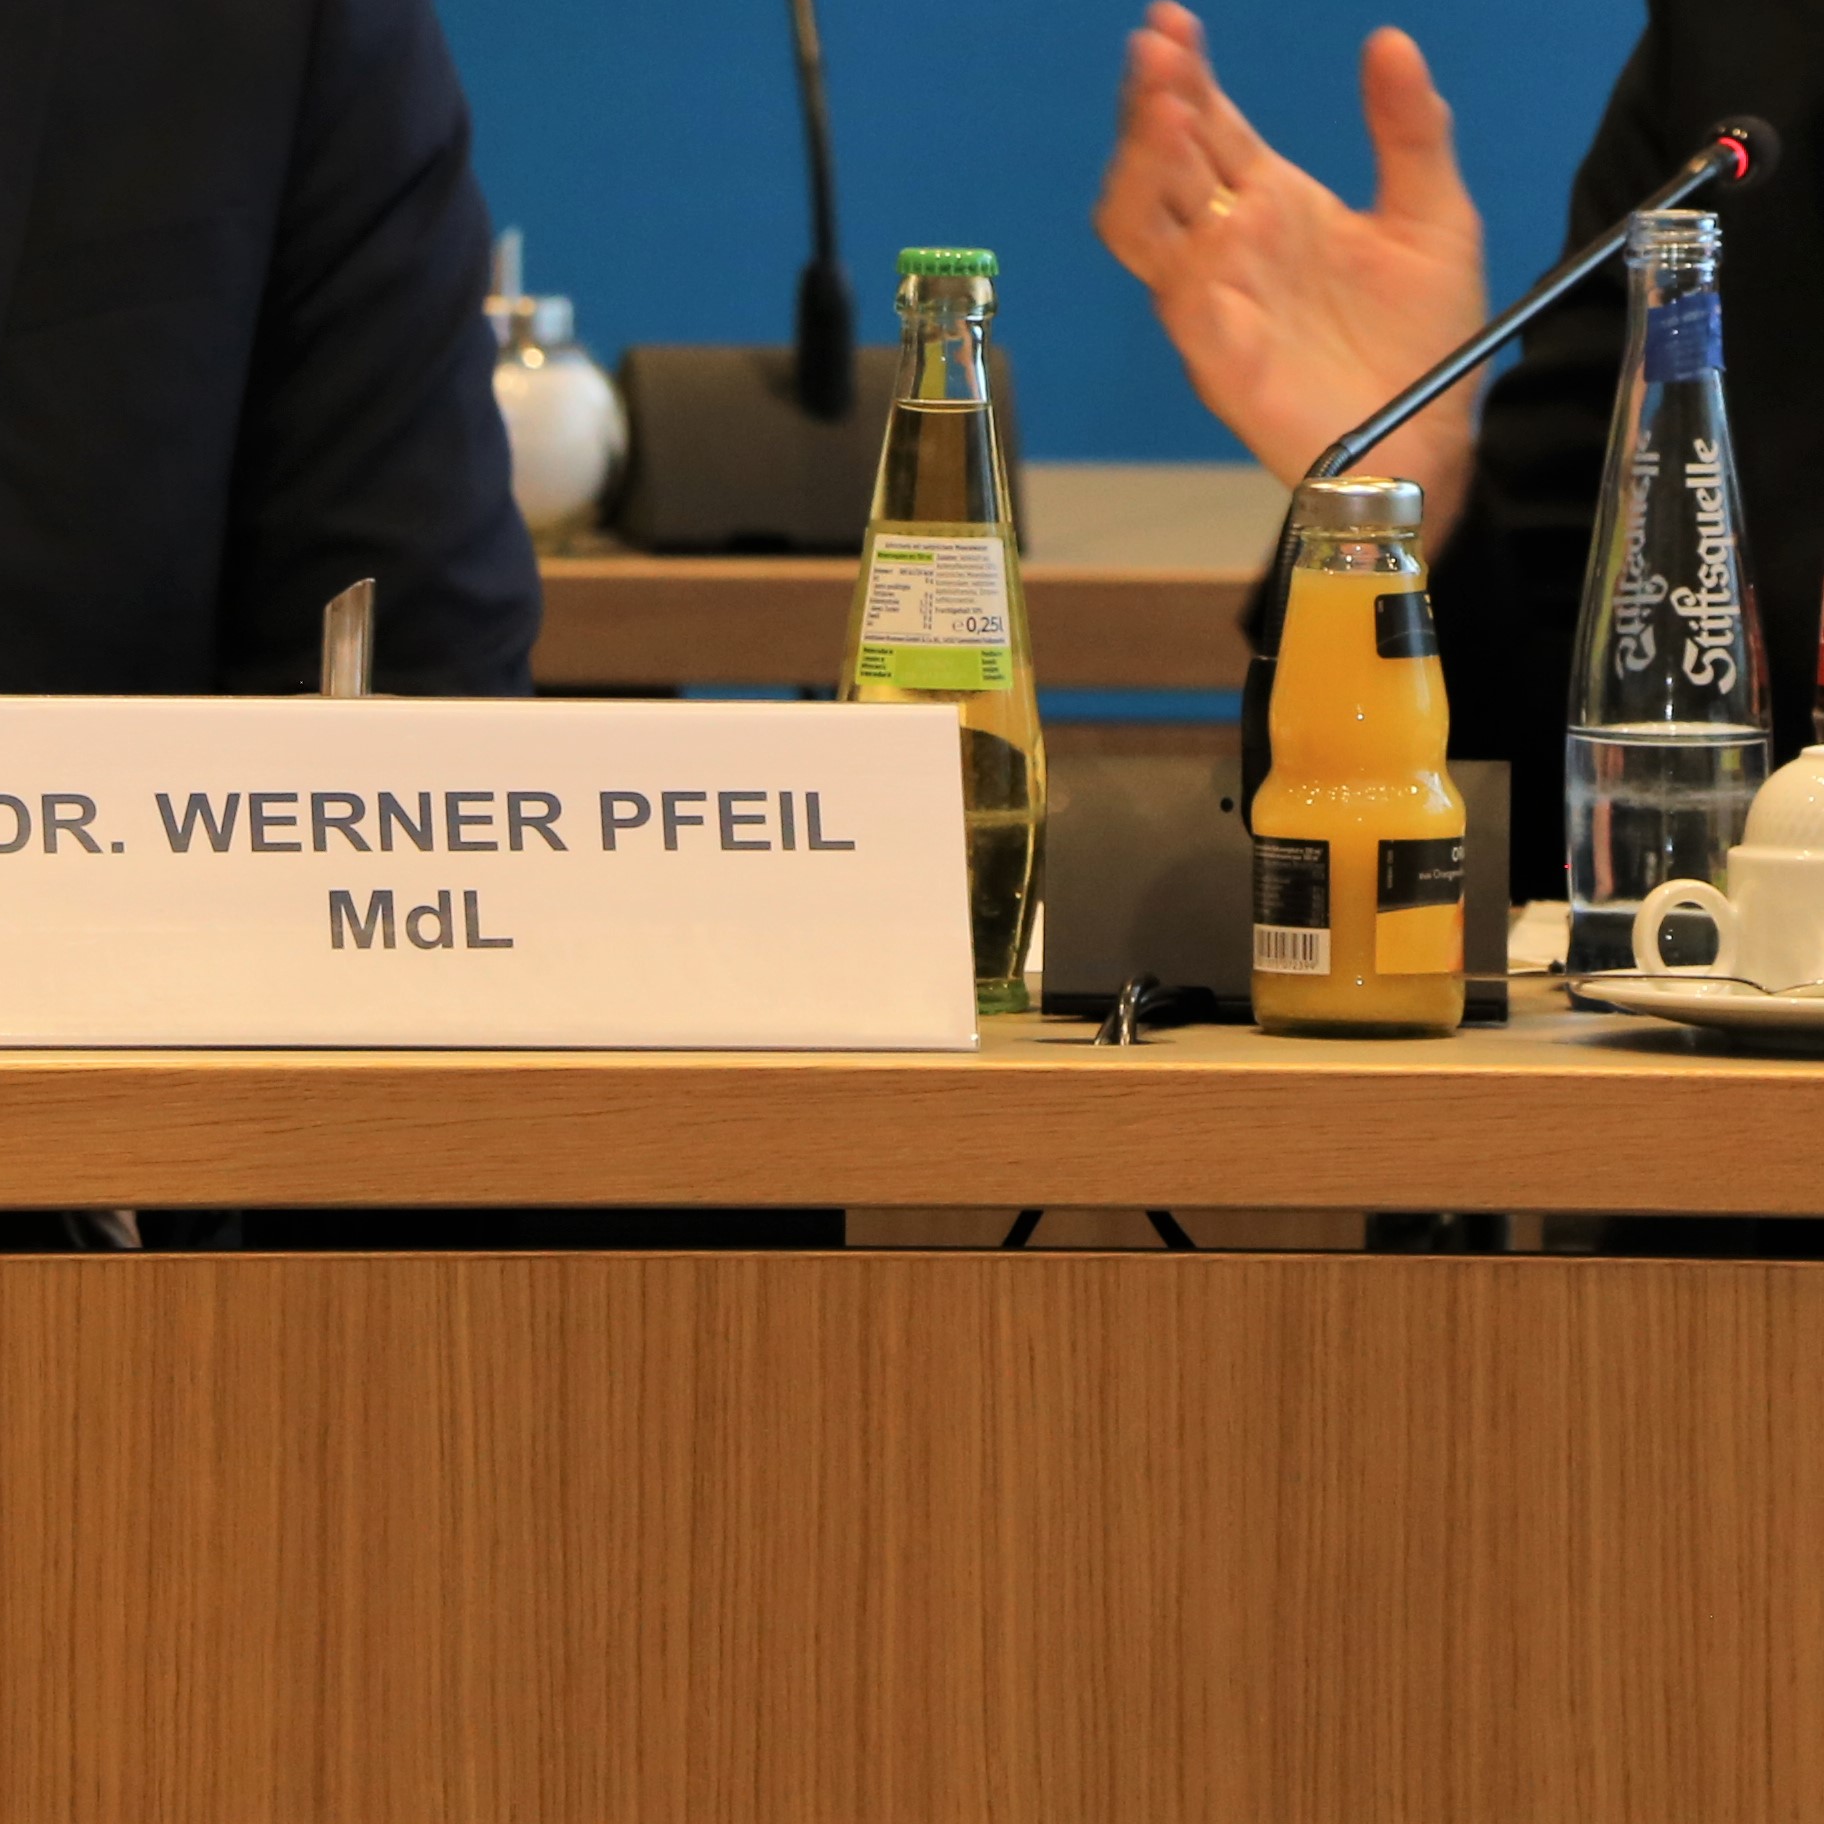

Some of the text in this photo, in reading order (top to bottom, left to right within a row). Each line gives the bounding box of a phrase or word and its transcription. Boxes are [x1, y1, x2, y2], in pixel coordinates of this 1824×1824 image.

[1669, 437, 1741, 695] Stiftsquelle
[155, 791, 568, 853] WERNER
[599, 791, 856, 851] PFEIL
[328, 889, 514, 950] MdL
